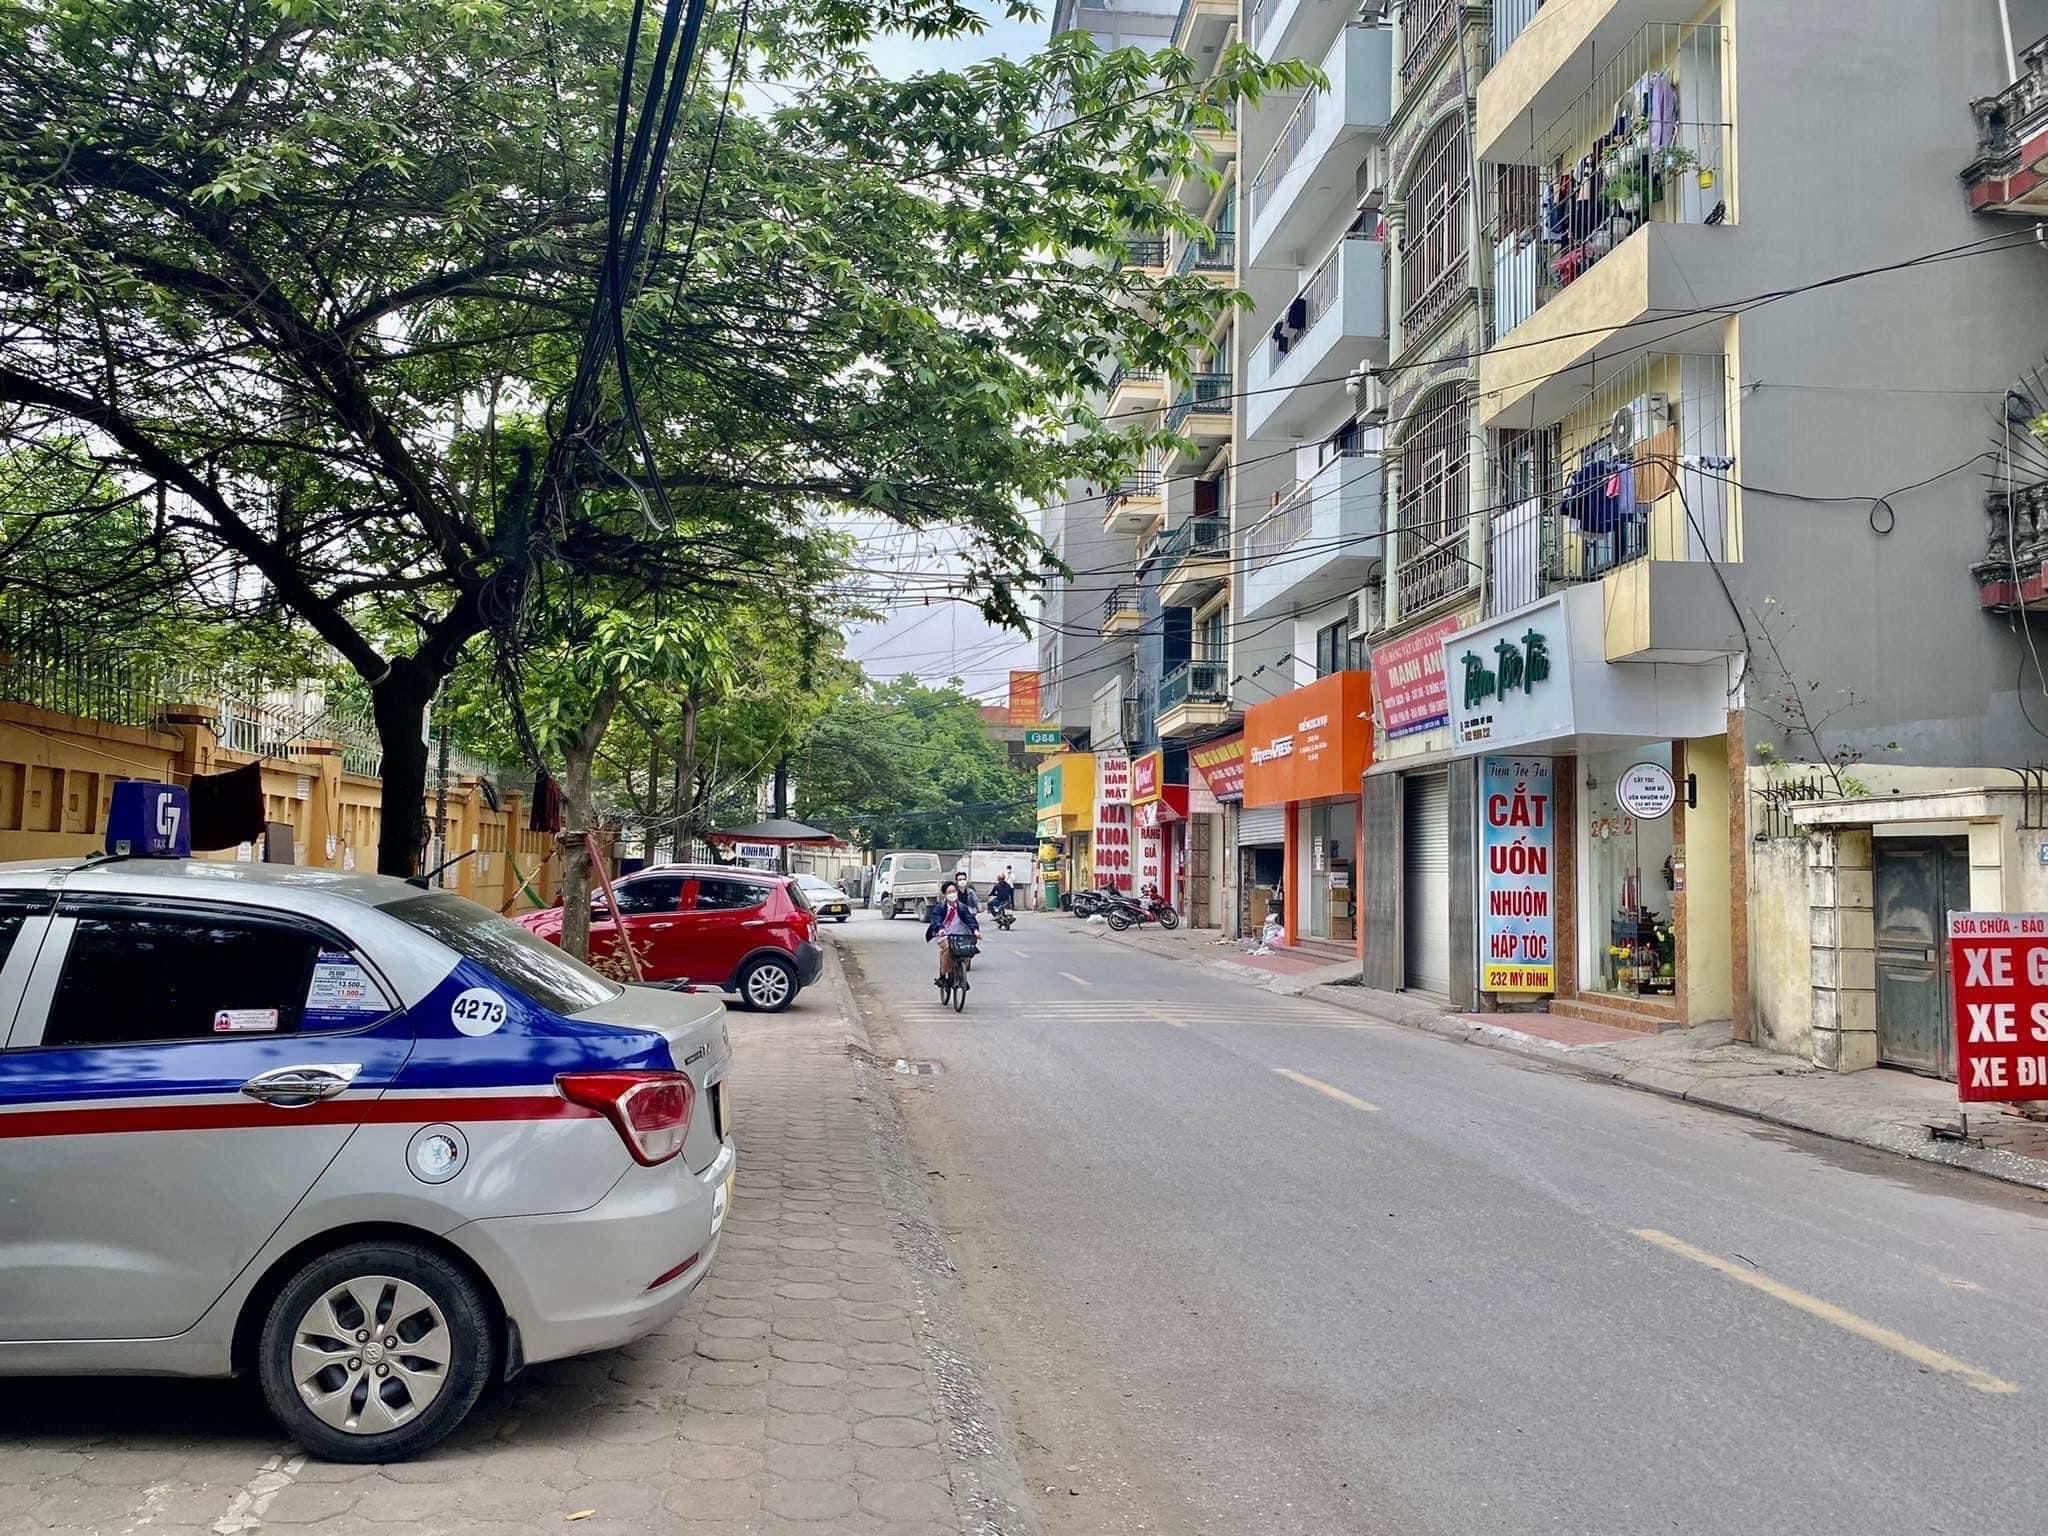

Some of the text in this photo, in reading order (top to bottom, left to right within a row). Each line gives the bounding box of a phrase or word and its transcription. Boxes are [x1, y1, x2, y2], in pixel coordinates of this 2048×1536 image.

[1388, 658, 1422, 689] MẠNH
[1105, 774, 1127, 784] HÀM
[1105, 788, 1127, 800] MẶT
[1488, 782, 1548, 827] CẮT
[1100, 805, 1126, 823] NHA
[1096, 828, 1129, 845] KHOA
[1096, 849, 1129, 870] NGỌC
[1490, 836, 1547, 875] UỐN
[1490, 885, 1548, 922] NHUỘM
[1953, 915, 1976, 934] SỬA
[1980, 915, 2010, 933] CHỮA
[2022, 915, 2044, 933] BẢO
[1491, 925, 1548, 959] HẤP TÓC
[1490, 968, 1549, 987] 232 MỸ ĐÌNH
[1964, 947, 2014, 987] XE
[453, 998, 504, 1024] 4273
[1967, 1004, 2017, 1042] XE
[1970, 1056, 2008, 1087] XE
